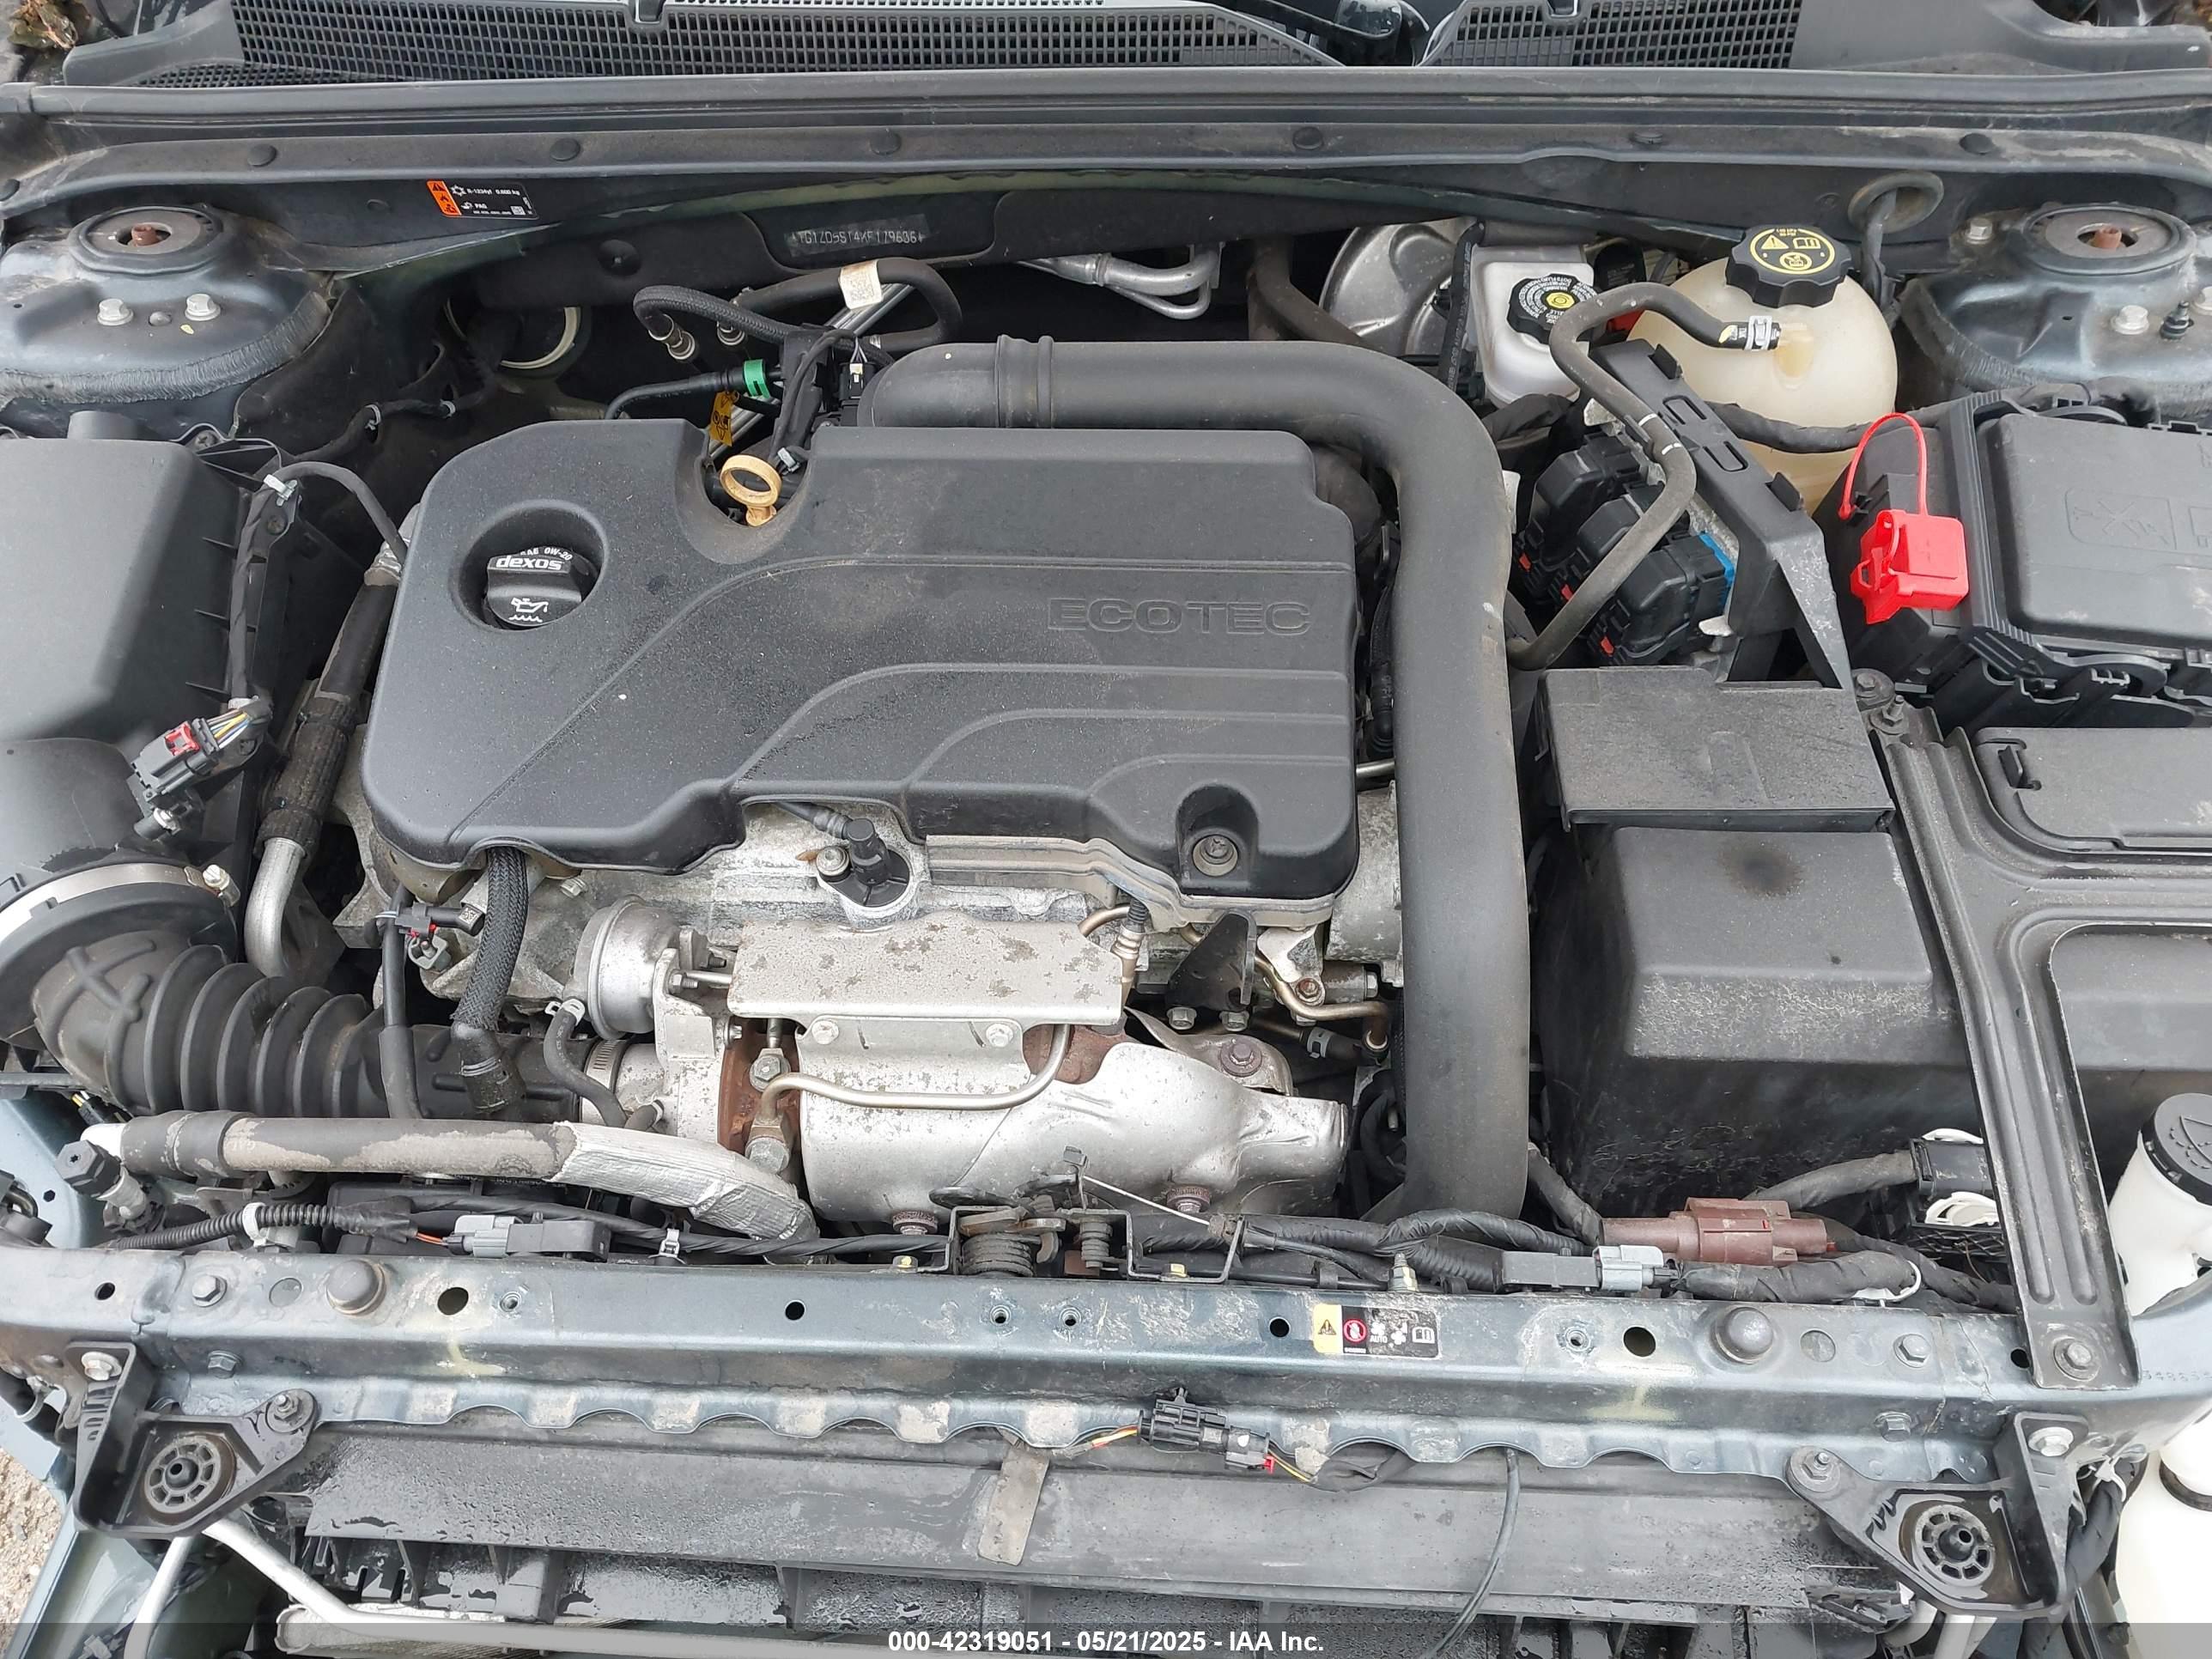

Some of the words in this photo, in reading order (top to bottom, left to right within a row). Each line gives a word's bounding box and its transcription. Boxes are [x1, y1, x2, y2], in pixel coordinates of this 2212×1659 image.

[496, 556, 564, 571] dexos
[1048, 598, 1311, 636] ECOTEC
[1370, 1335, 1388, 1344] AUTO
